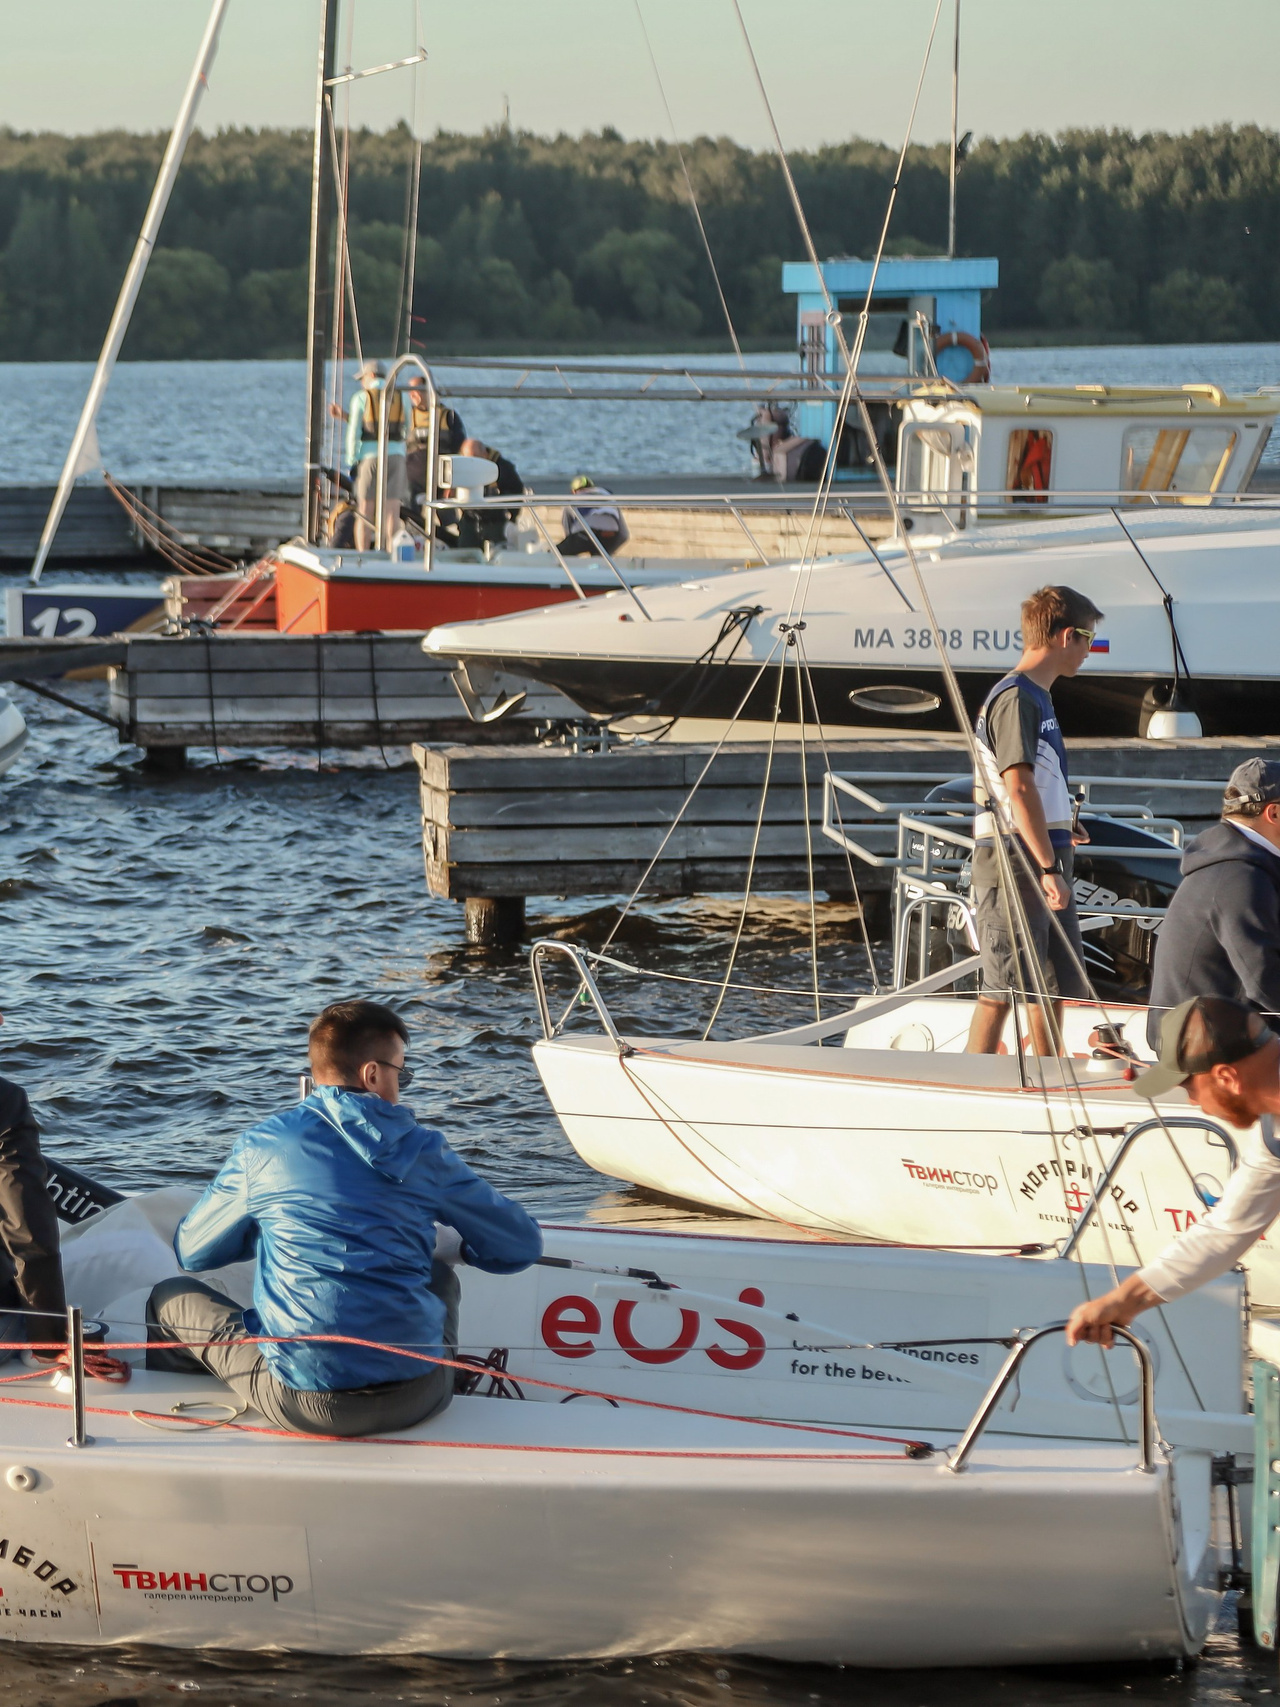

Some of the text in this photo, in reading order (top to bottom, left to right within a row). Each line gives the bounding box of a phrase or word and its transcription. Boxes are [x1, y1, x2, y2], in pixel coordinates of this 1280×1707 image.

[31, 606, 97, 638] 12
[854, 628, 895, 648] MA
[903, 629, 962, 650] 3808
[1020, 1160, 1139, 1213] МОРПРИОР
[791, 1359, 819, 1375] for
[824, 1362, 856, 1379] the
[144, 1591, 254, 1604] галерея интерьеров
[19, 1609, 62, 1619] ЧАСЫ
